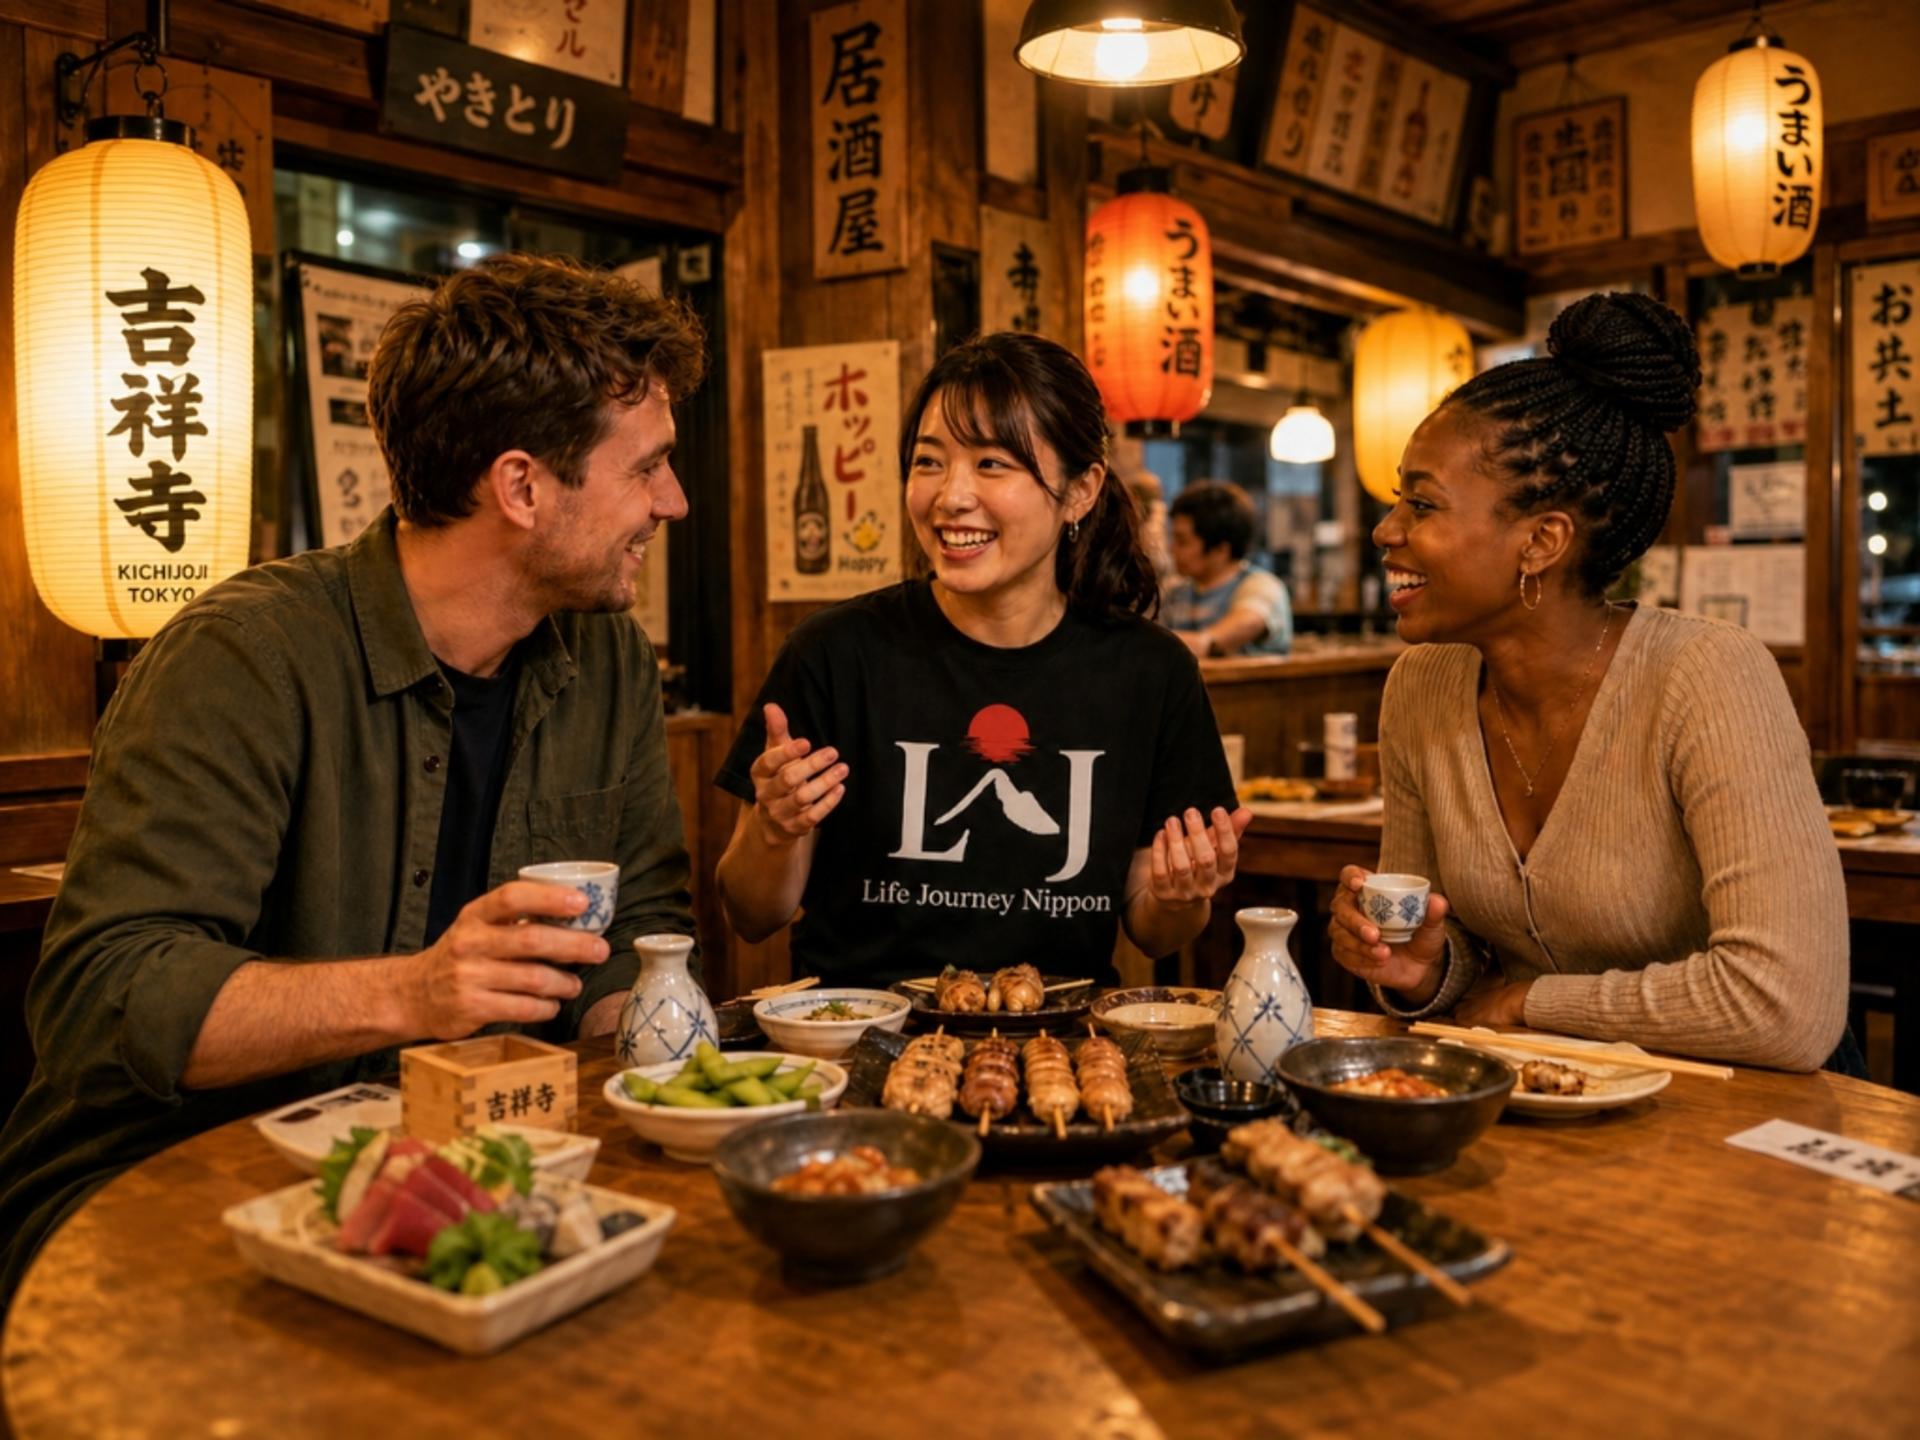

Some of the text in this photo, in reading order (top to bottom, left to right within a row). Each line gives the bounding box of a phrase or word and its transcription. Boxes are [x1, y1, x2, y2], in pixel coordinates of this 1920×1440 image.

[414, 66, 576, 150] やきとり
[822, 20, 885, 256] 居酒屋
[1773, 64, 1813, 231] うまい酒
[1160, 218, 1202, 379] うまい酒
[105, 267, 208, 553] 吉祥寺
[822, 362, 876, 522] ホッピー
[117, 564, 208, 580] KICHIJOJI
[127, 586, 196, 603] TOKYO
[863, 879, 1112, 918] Life Journey Nippon
[485, 1082, 557, 1123] 吉祥寺
